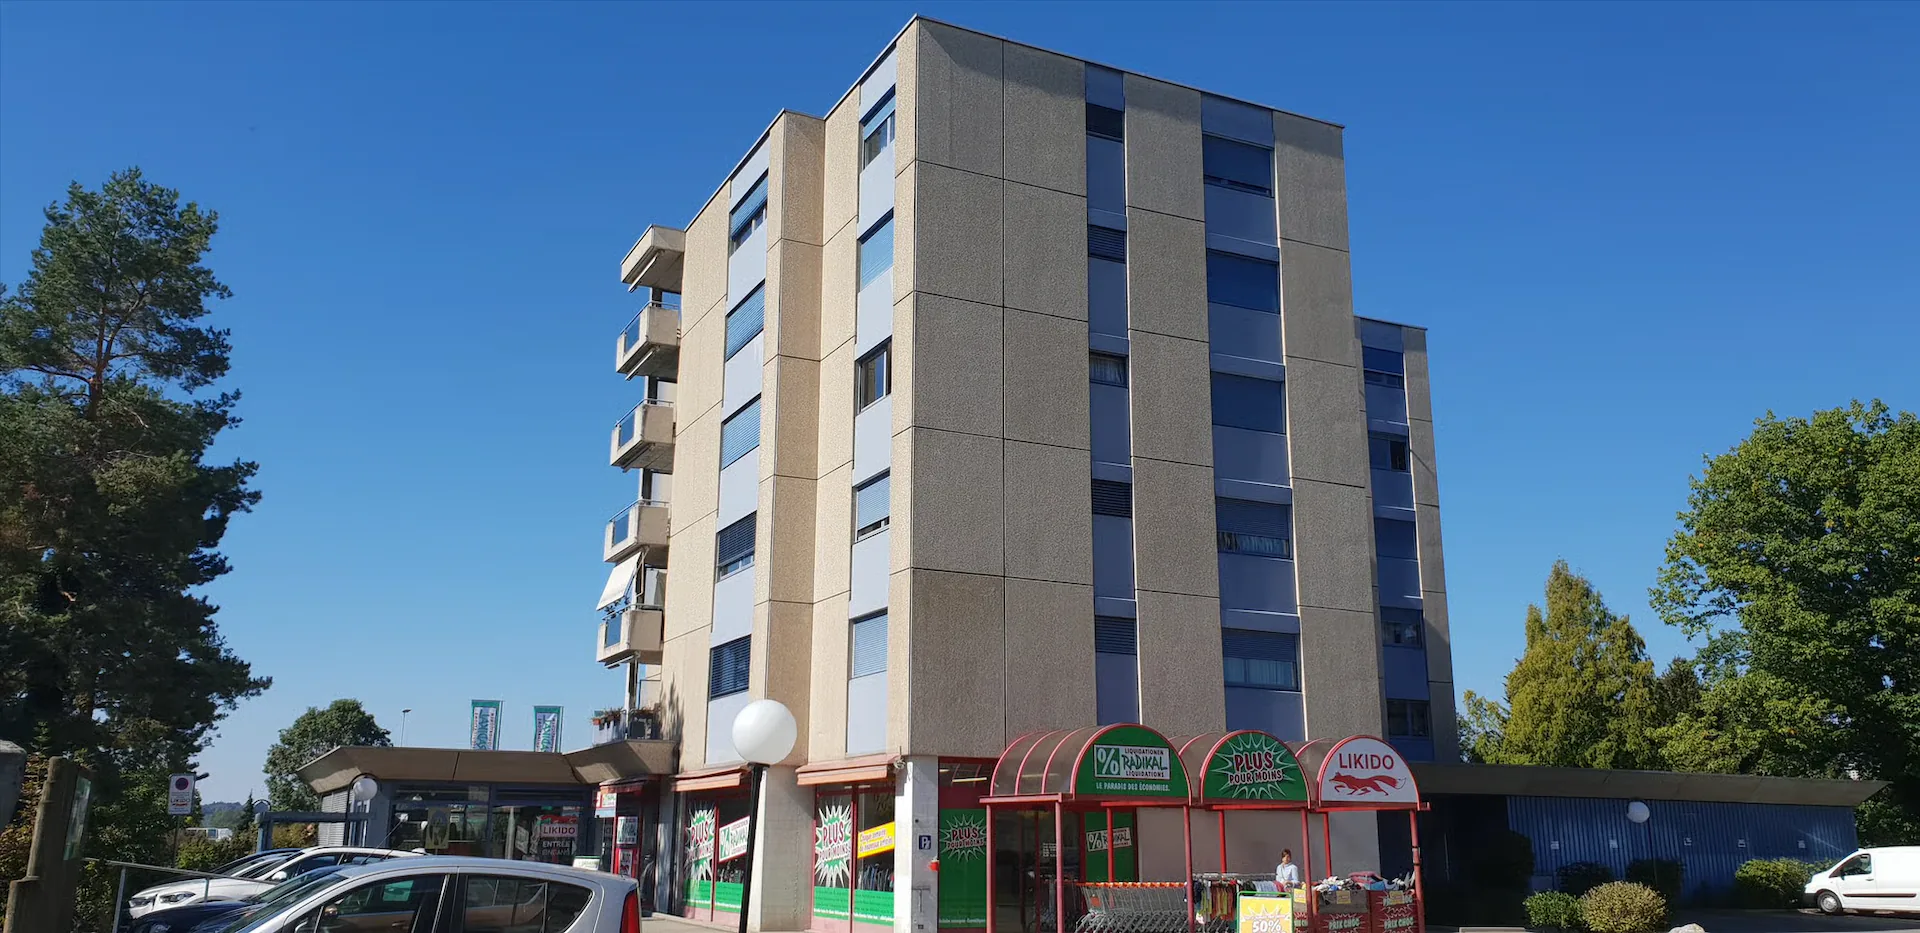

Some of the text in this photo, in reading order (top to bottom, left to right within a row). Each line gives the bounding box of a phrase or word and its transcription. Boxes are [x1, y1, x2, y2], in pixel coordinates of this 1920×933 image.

[1121, 754, 1168, 771] RADIKAL
[1233, 751, 1274, 772] PLUS
[1339, 753, 1394, 770] LIKIDO
[1229, 769, 1283, 784] POUR MOINS
[1096, 782, 1103, 790] LE
[1104, 782, 1127, 791] PARADIS
[1127, 783, 1138, 791] DES
[691, 820, 709, 844] PLUS
[822, 821, 844, 845] PLUS
[951, 827, 979, 840] PLUS
[1252, 920, 1282, 933] 50%
[1328, 918, 1343, 930] PRIX
[1384, 917, 1414, 930] PRIX CHOC
